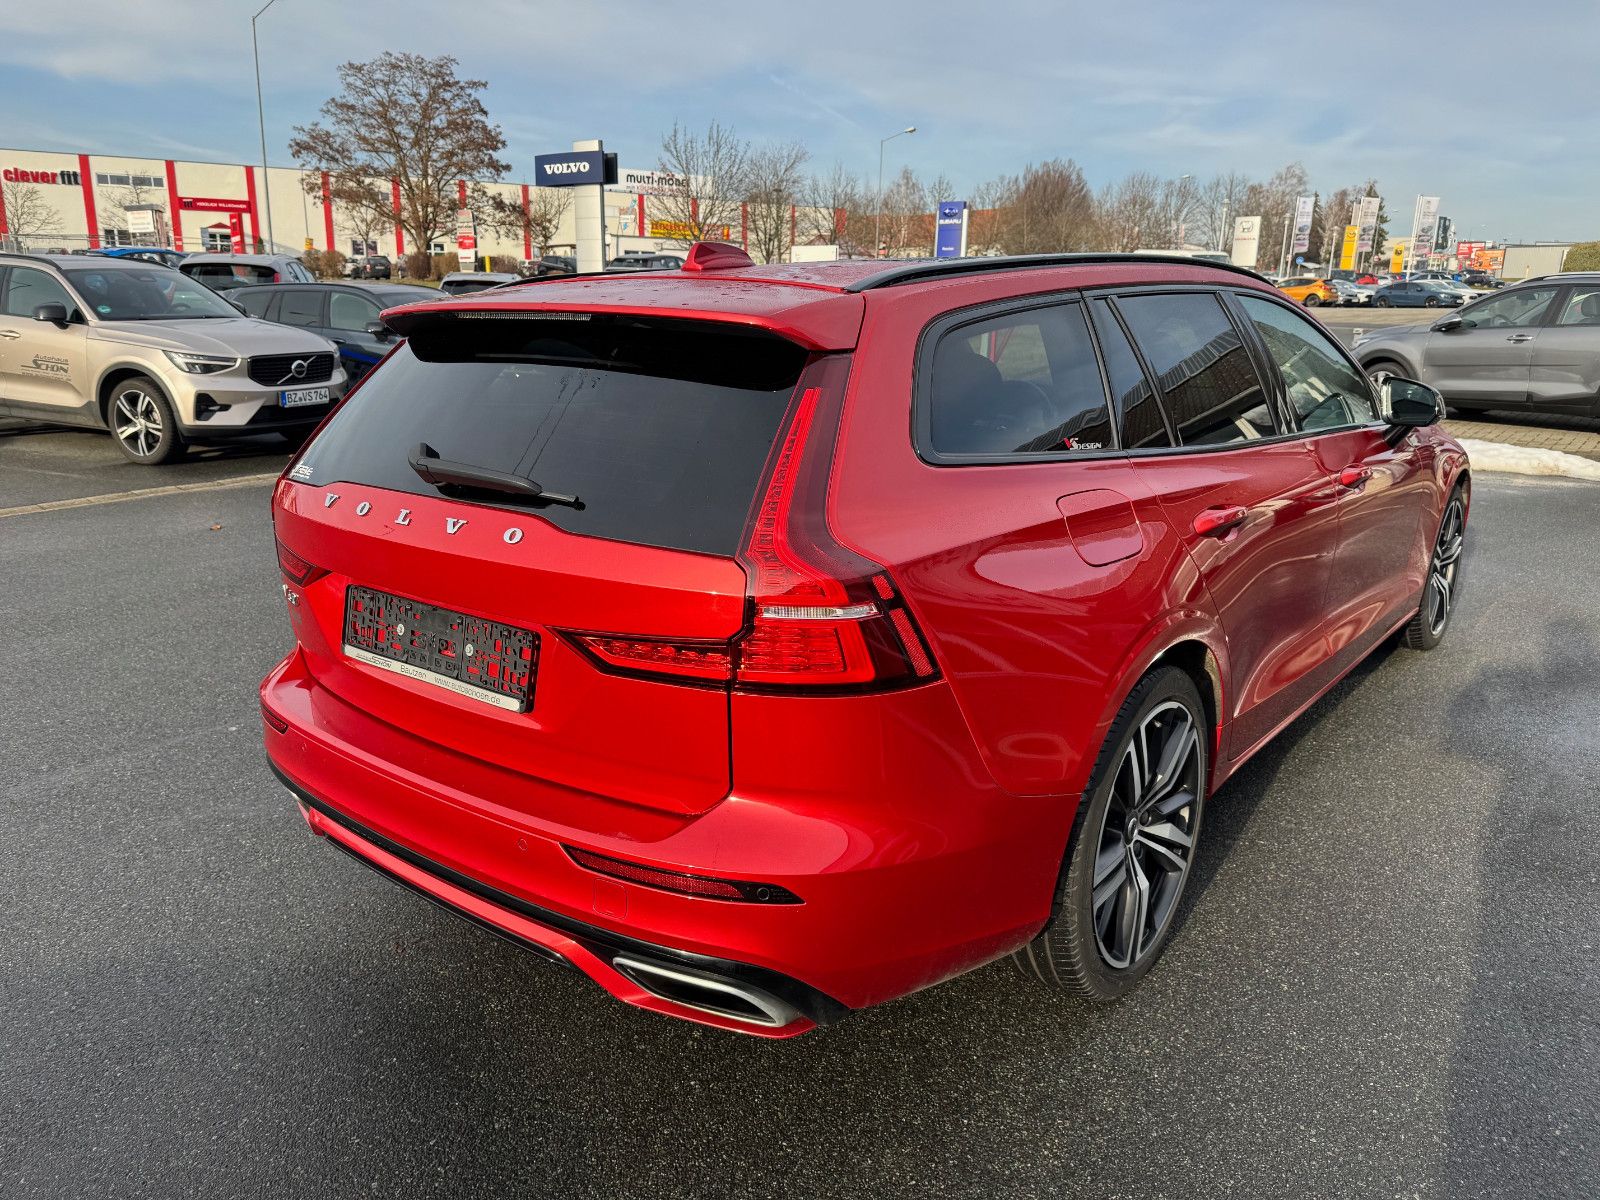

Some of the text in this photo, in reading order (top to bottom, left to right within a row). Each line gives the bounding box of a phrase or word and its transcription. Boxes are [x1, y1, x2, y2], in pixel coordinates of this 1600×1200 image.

[3, 167, 80, 185] clever fit
[544, 162, 590, 175] VOLVO
[324, 493, 524, 544] VOLVO
[400, 664, 427, 679] Bautzen
